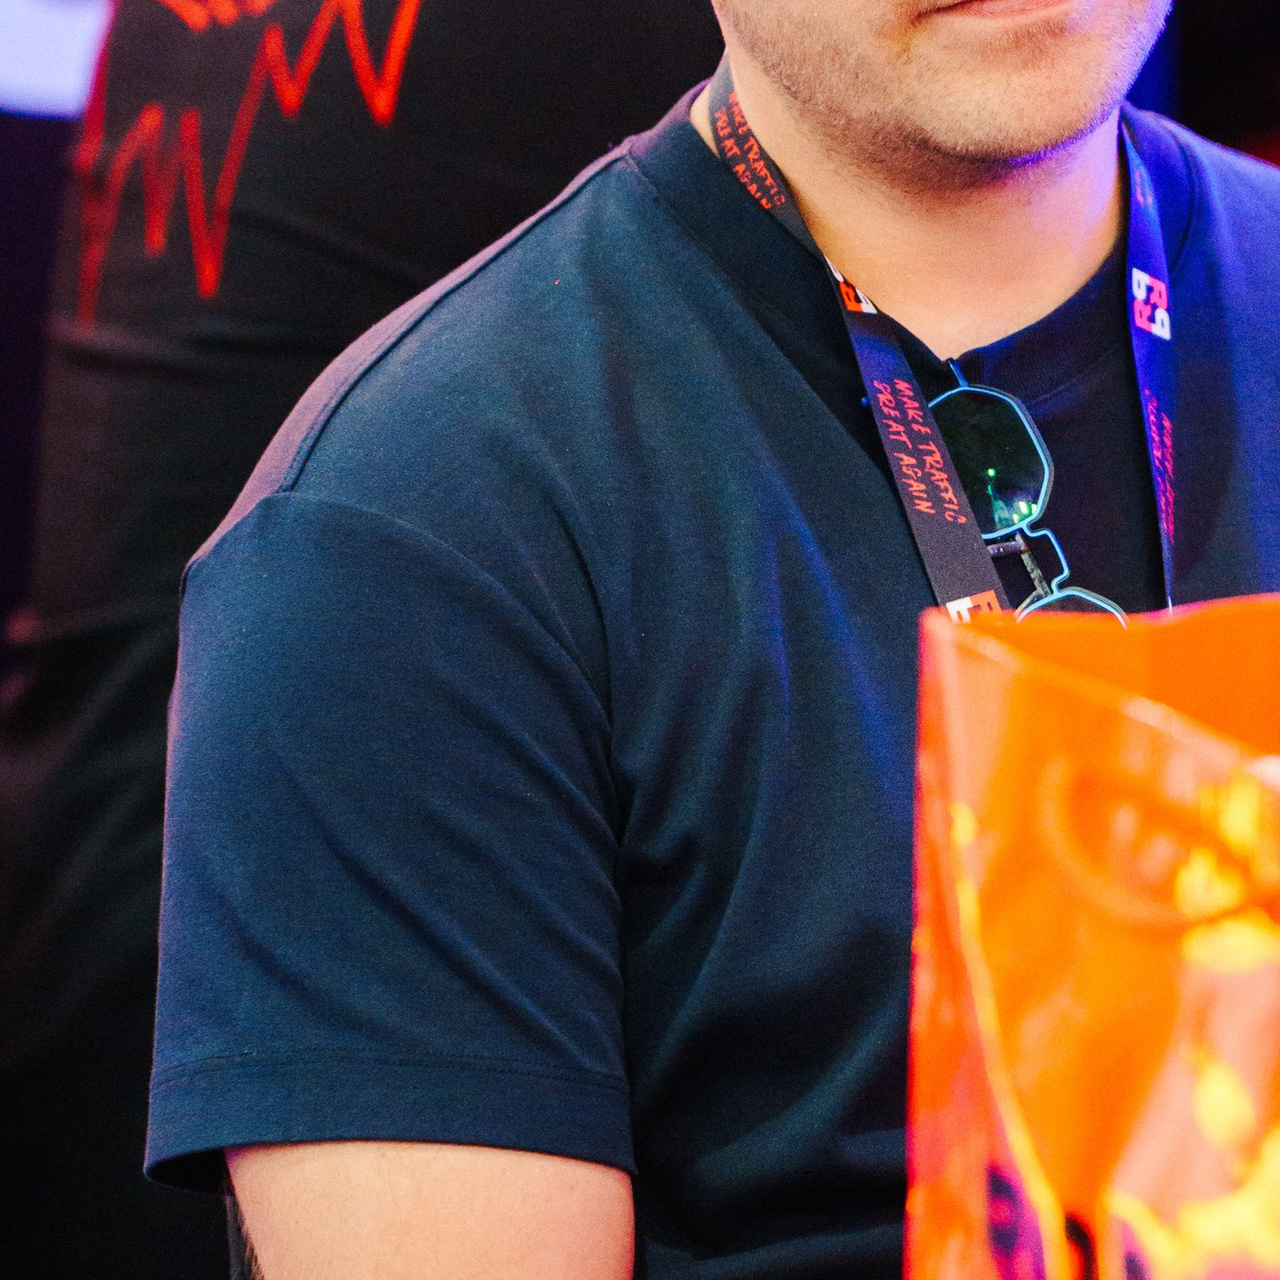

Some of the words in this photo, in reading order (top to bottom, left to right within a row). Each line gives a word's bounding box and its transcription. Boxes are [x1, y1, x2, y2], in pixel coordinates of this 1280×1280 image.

[743, 136, 785, 206] TRAFFIC
[873, 380, 913, 450] GREAT
[893, 452, 936, 514] AGAIN
[893, 378, 932, 435] MAKE
[918, 440, 967, 525] TRAFFIC
